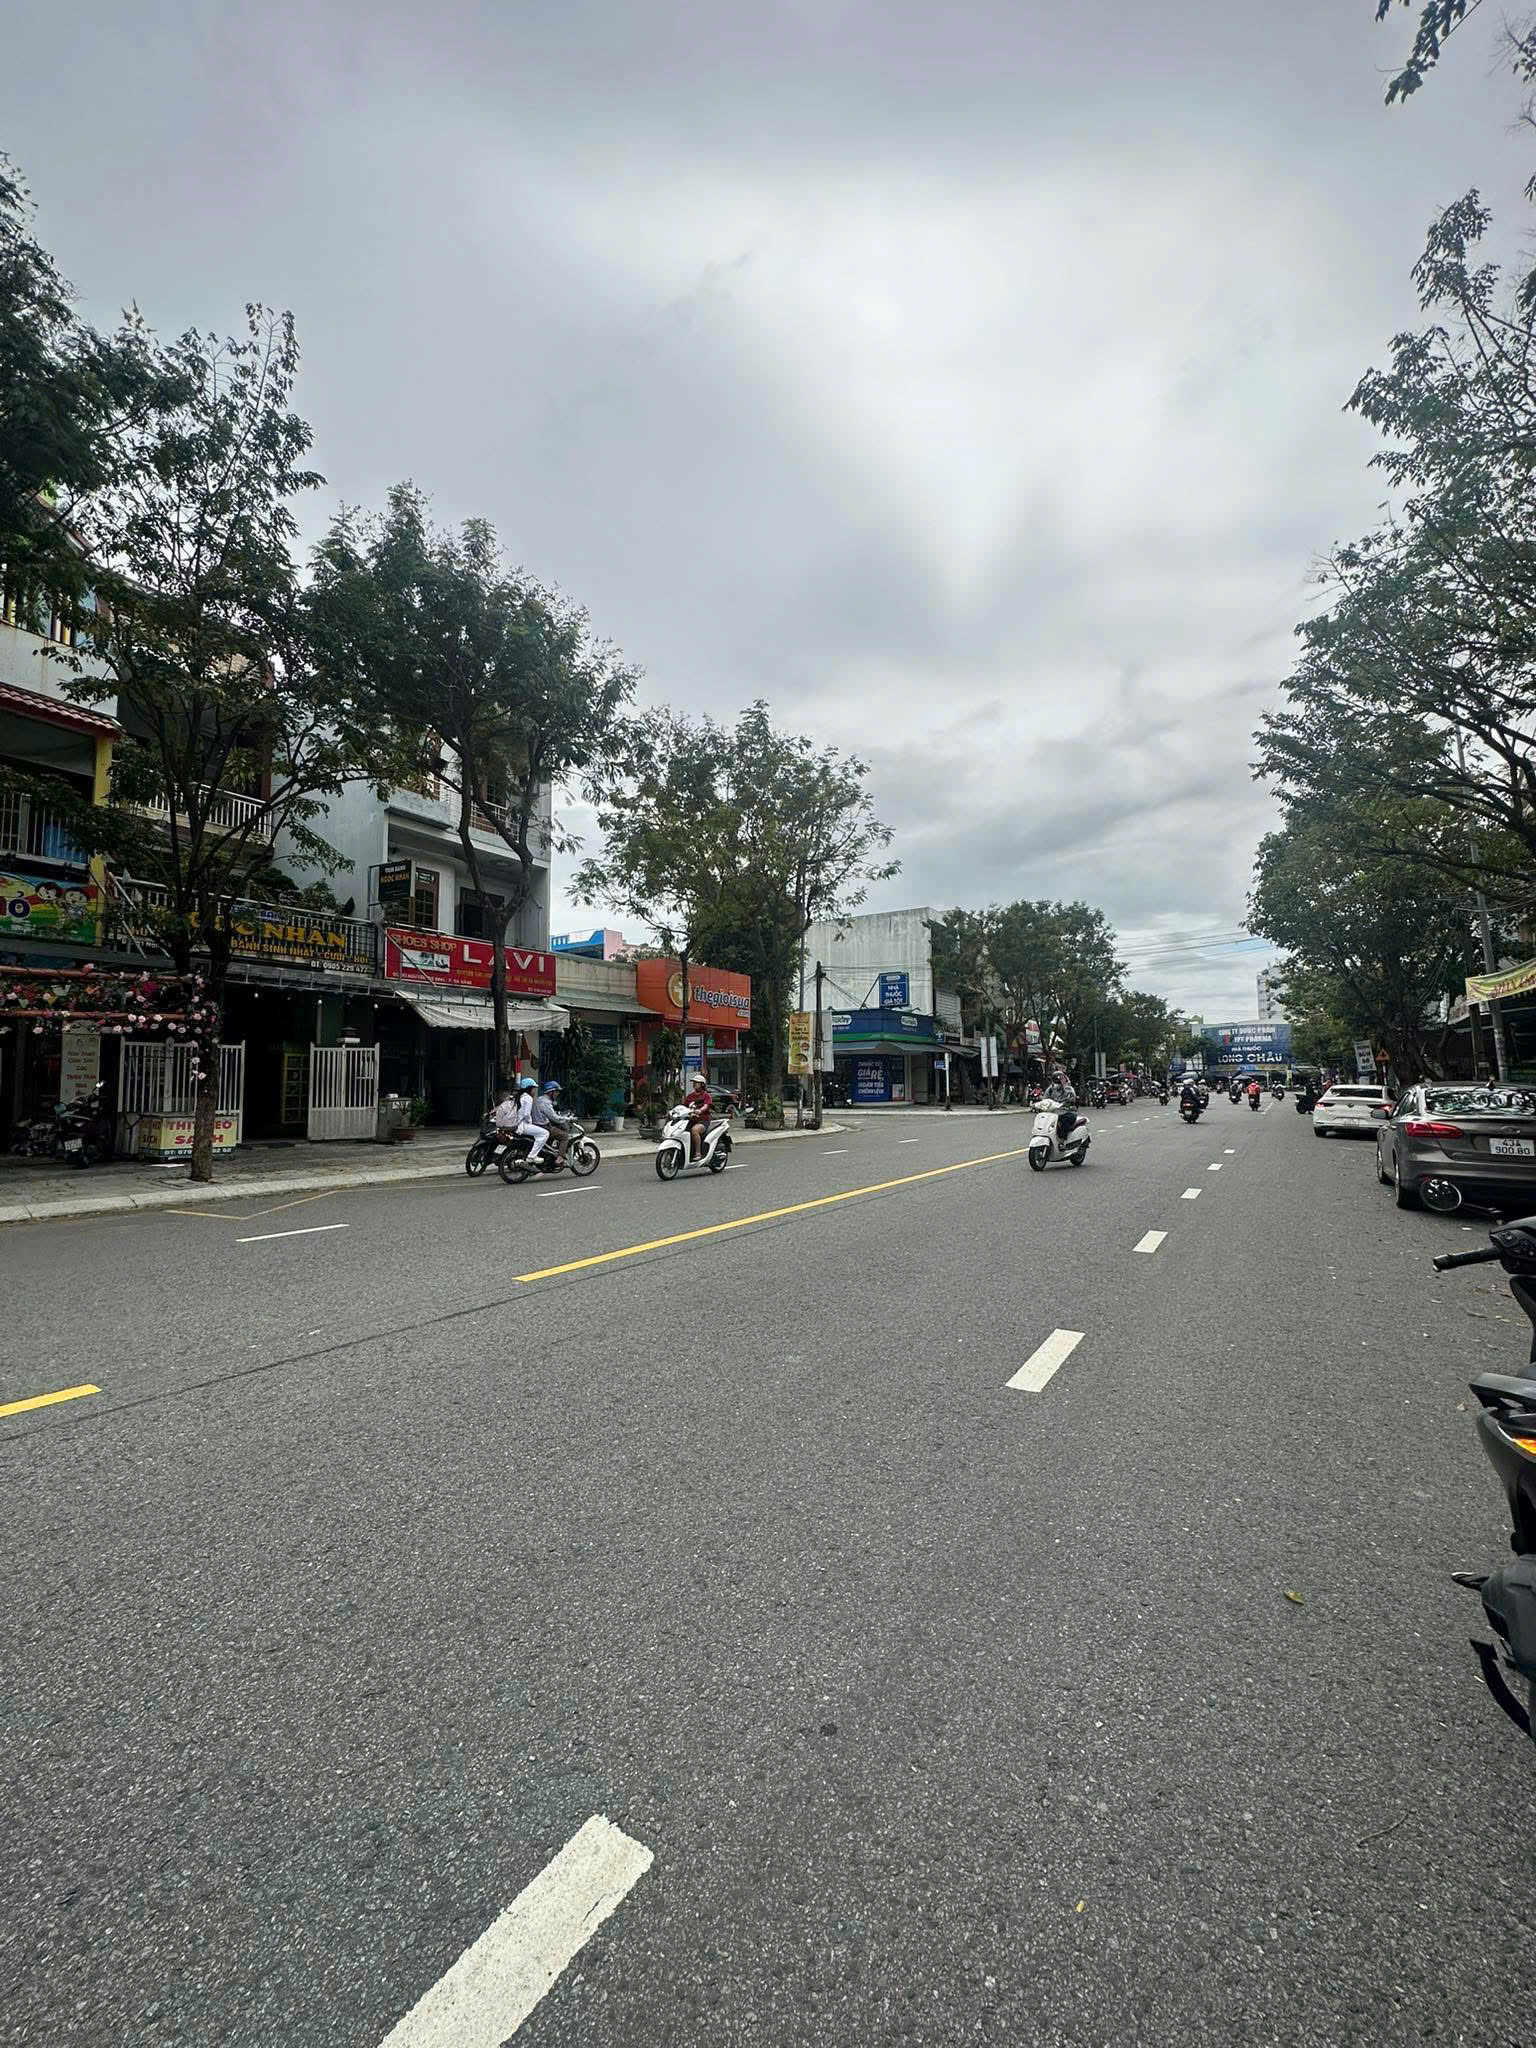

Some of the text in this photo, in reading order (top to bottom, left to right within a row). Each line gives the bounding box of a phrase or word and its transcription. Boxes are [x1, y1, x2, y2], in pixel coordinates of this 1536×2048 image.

[391, 934, 457, 952] SHOES SHOP
[1218, 1054, 1244, 1063] LONG
[168, 1120, 195, 1133] THỊ
[175, 1135, 225, 1147] SH
